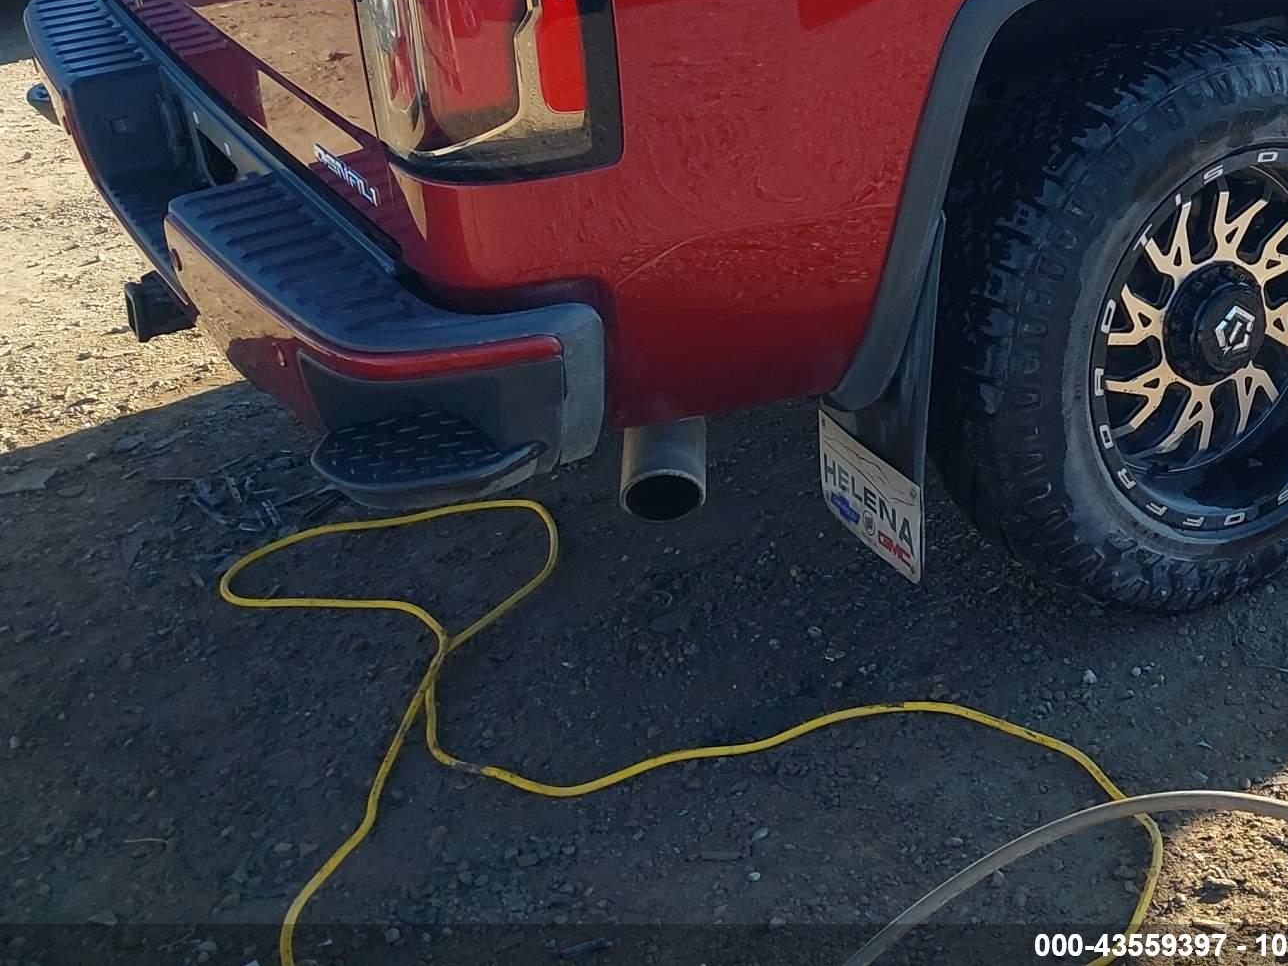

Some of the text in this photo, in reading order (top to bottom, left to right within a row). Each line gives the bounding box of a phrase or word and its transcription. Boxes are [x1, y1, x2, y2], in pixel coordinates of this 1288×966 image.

[313, 144, 378, 207] DENALI
[824, 452, 914, 558] HELENA
[878, 531, 912, 567] GMC
